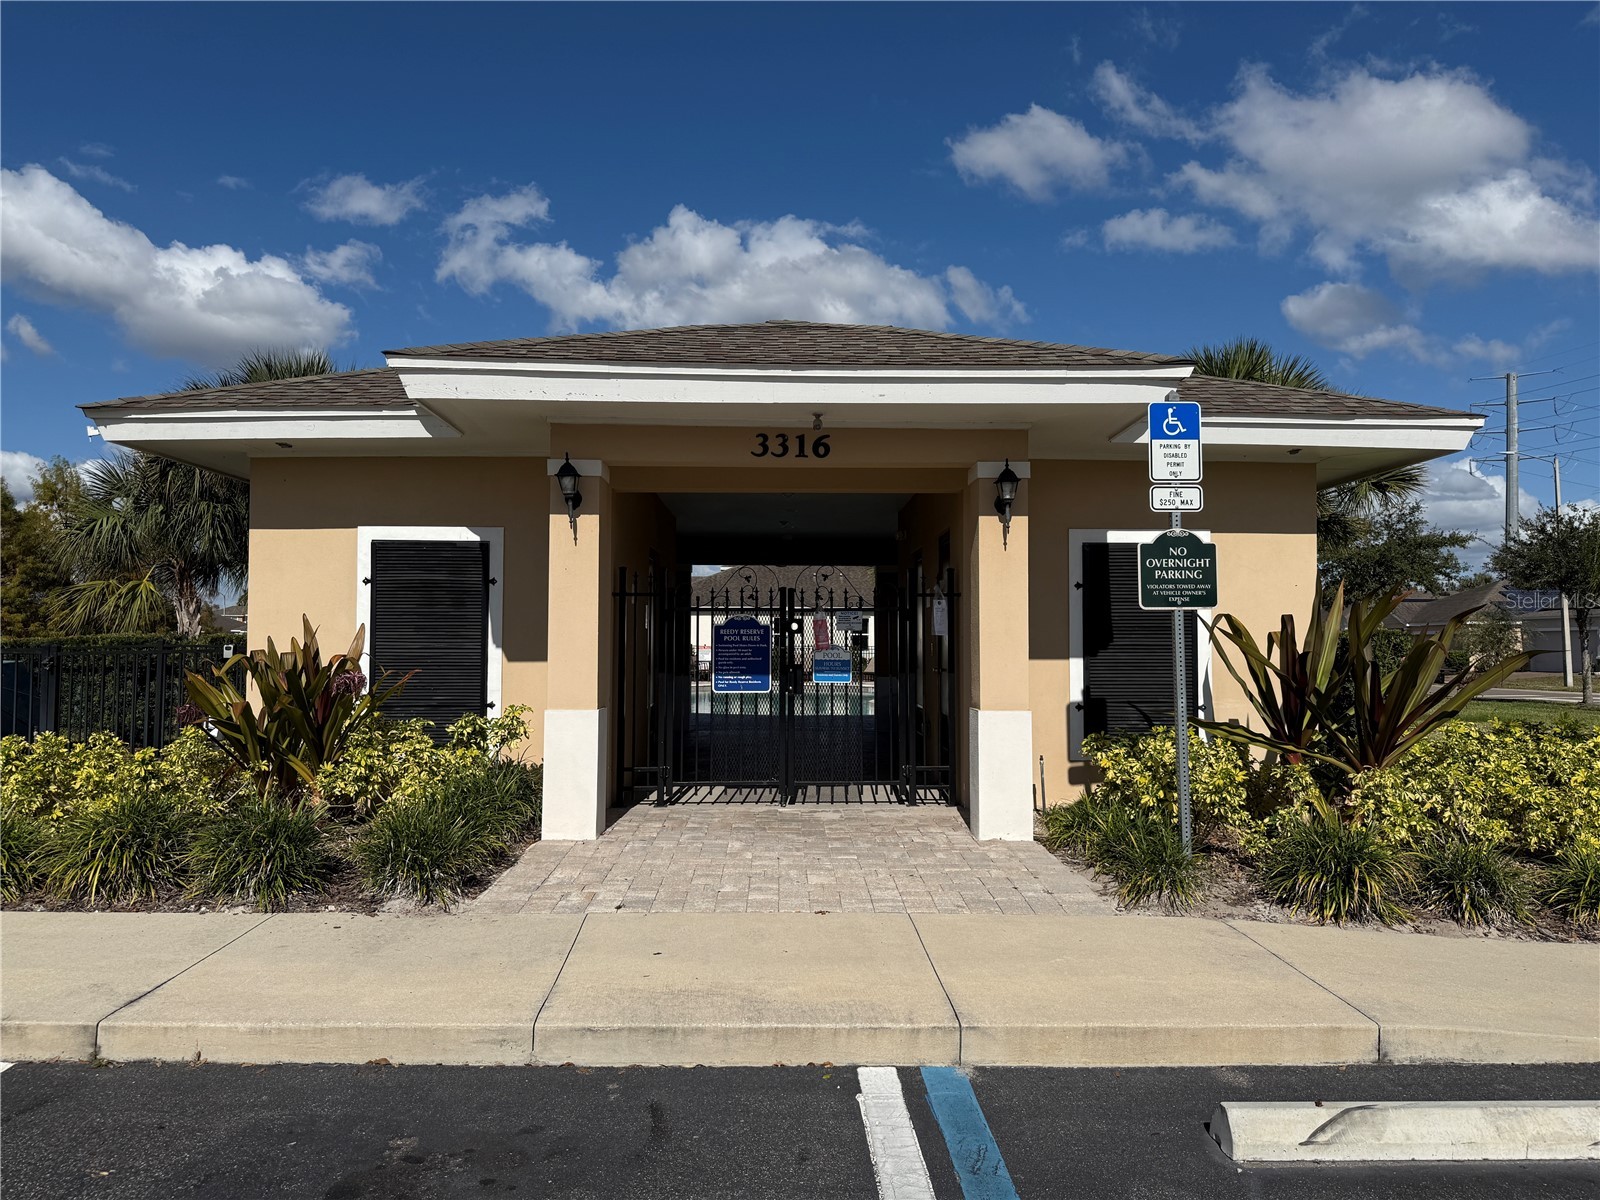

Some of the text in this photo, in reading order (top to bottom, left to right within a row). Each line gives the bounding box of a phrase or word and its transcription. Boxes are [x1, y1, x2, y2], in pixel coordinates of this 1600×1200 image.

[750, 432, 831, 458] 3316
[1169, 546, 1187, 556] NO
[1146, 558, 1210, 568] OVERNIGHT
[1155, 570, 1202, 579] PARKING
